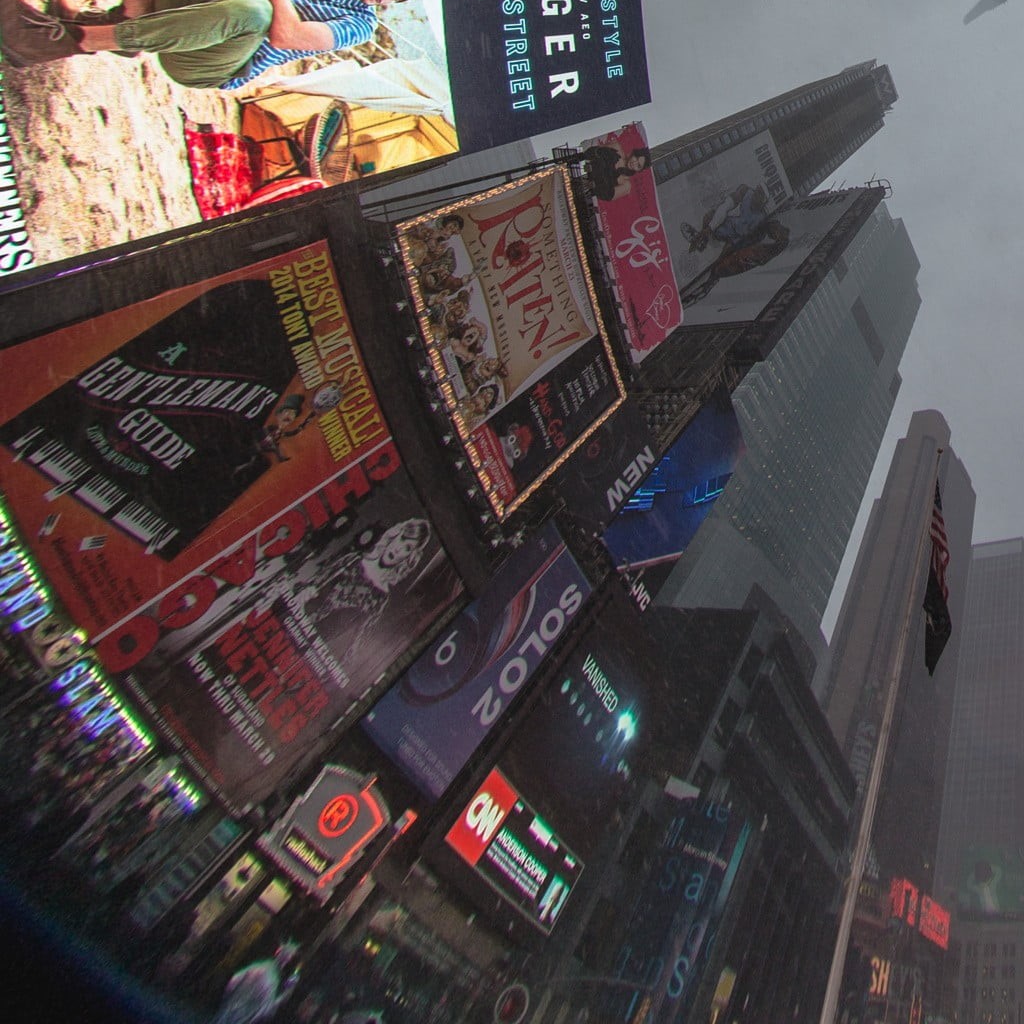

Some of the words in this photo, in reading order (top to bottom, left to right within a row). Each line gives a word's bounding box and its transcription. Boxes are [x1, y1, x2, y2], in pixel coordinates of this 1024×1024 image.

[580, 13, 590, 40] AEO
[542, 202, 579, 322] SOMETHING
[614, 215, 669, 271] Gigi
[266, 264, 297, 304] 2014
[291, 251, 343, 327] BEST
[277, 300, 309, 341] TONY
[157, 340, 187, 366] A
[291, 340, 323, 390] AWARD
[76, 354, 277, 418] GENTLEMAN'S
[312, 323, 385, 448] MUSICAL!
[116, 403, 194, 472] GUIDE
[317, 409, 352, 462] WINNER
[607, 445, 655, 512] NEW
[92, 440, 402, 674] CHICAGO
[631, 582, 652, 612] JVC
[211, 623, 306, 745] NETTLES
[221, 674, 235, 688] OF
[241, 607, 332, 718] JENNIFER
[308, 636, 351, 689] WELCOMES
[471, 583, 583, 727] SOLO2
[580, 652, 618, 714] VANISHED
[49, 657, 127, 739] SLAM
[185, 652, 215, 683] NOW
[205, 679, 237, 715] THRU
[226, 709, 266, 753] MARCH
[465, 790, 506, 842] CNN
[494, 827, 530, 864] ANDERSON
[522, 854, 549, 885] COOPER
